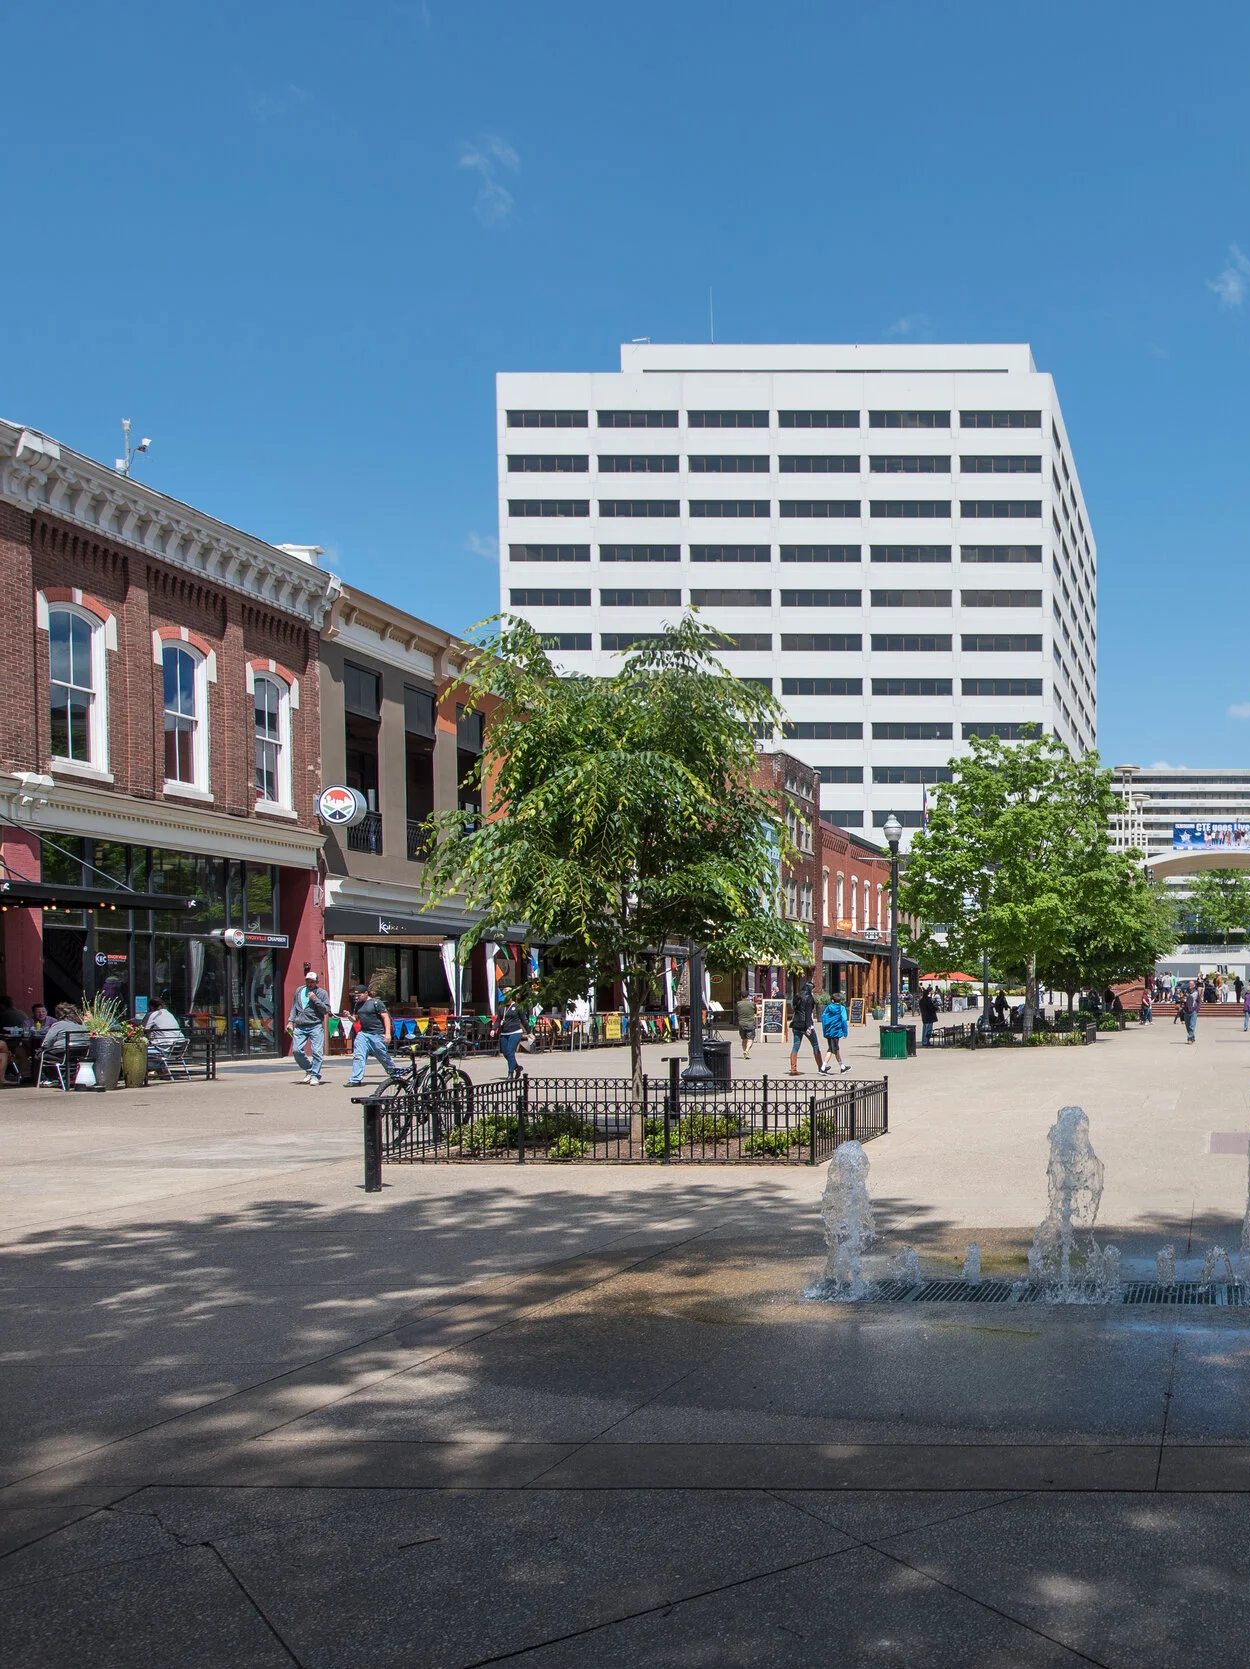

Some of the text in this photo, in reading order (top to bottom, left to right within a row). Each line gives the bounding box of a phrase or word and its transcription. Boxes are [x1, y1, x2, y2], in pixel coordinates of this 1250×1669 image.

[1196, 823, 1211, 832] CTE
[1212, 824, 1232, 833] goes
[1234, 824, 1250, 832] Live
